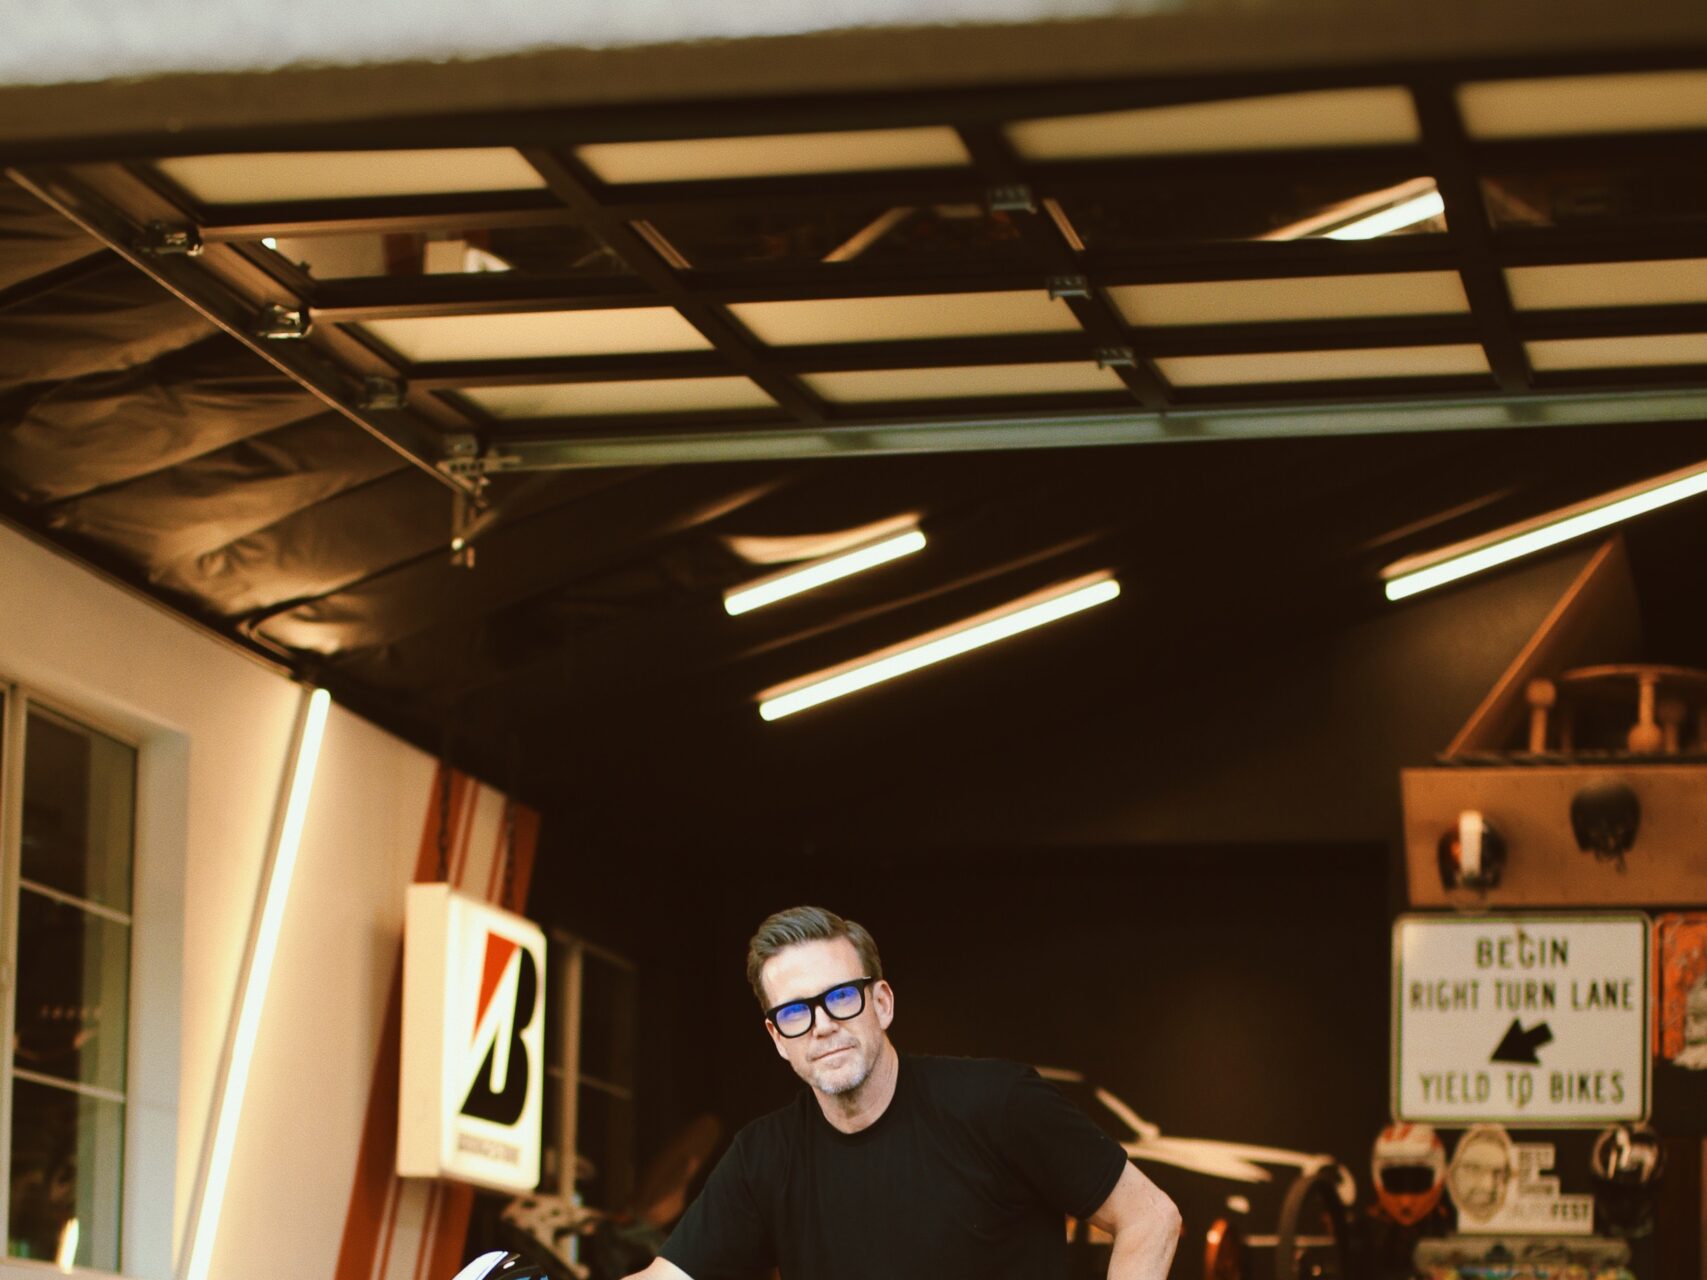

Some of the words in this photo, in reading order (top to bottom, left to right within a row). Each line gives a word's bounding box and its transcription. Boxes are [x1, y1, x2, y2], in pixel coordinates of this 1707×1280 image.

[1476, 937, 1569, 968] BEGIN
[1410, 979, 1479, 1010] RIGHT
[1495, 979, 1557, 1010] TURN
[1571, 979, 1634, 1010] LANE
[1419, 1071, 1491, 1103] YIELD
[1506, 1071, 1534, 1103] TO
[1550, 1071, 1625, 1104] BIKES
